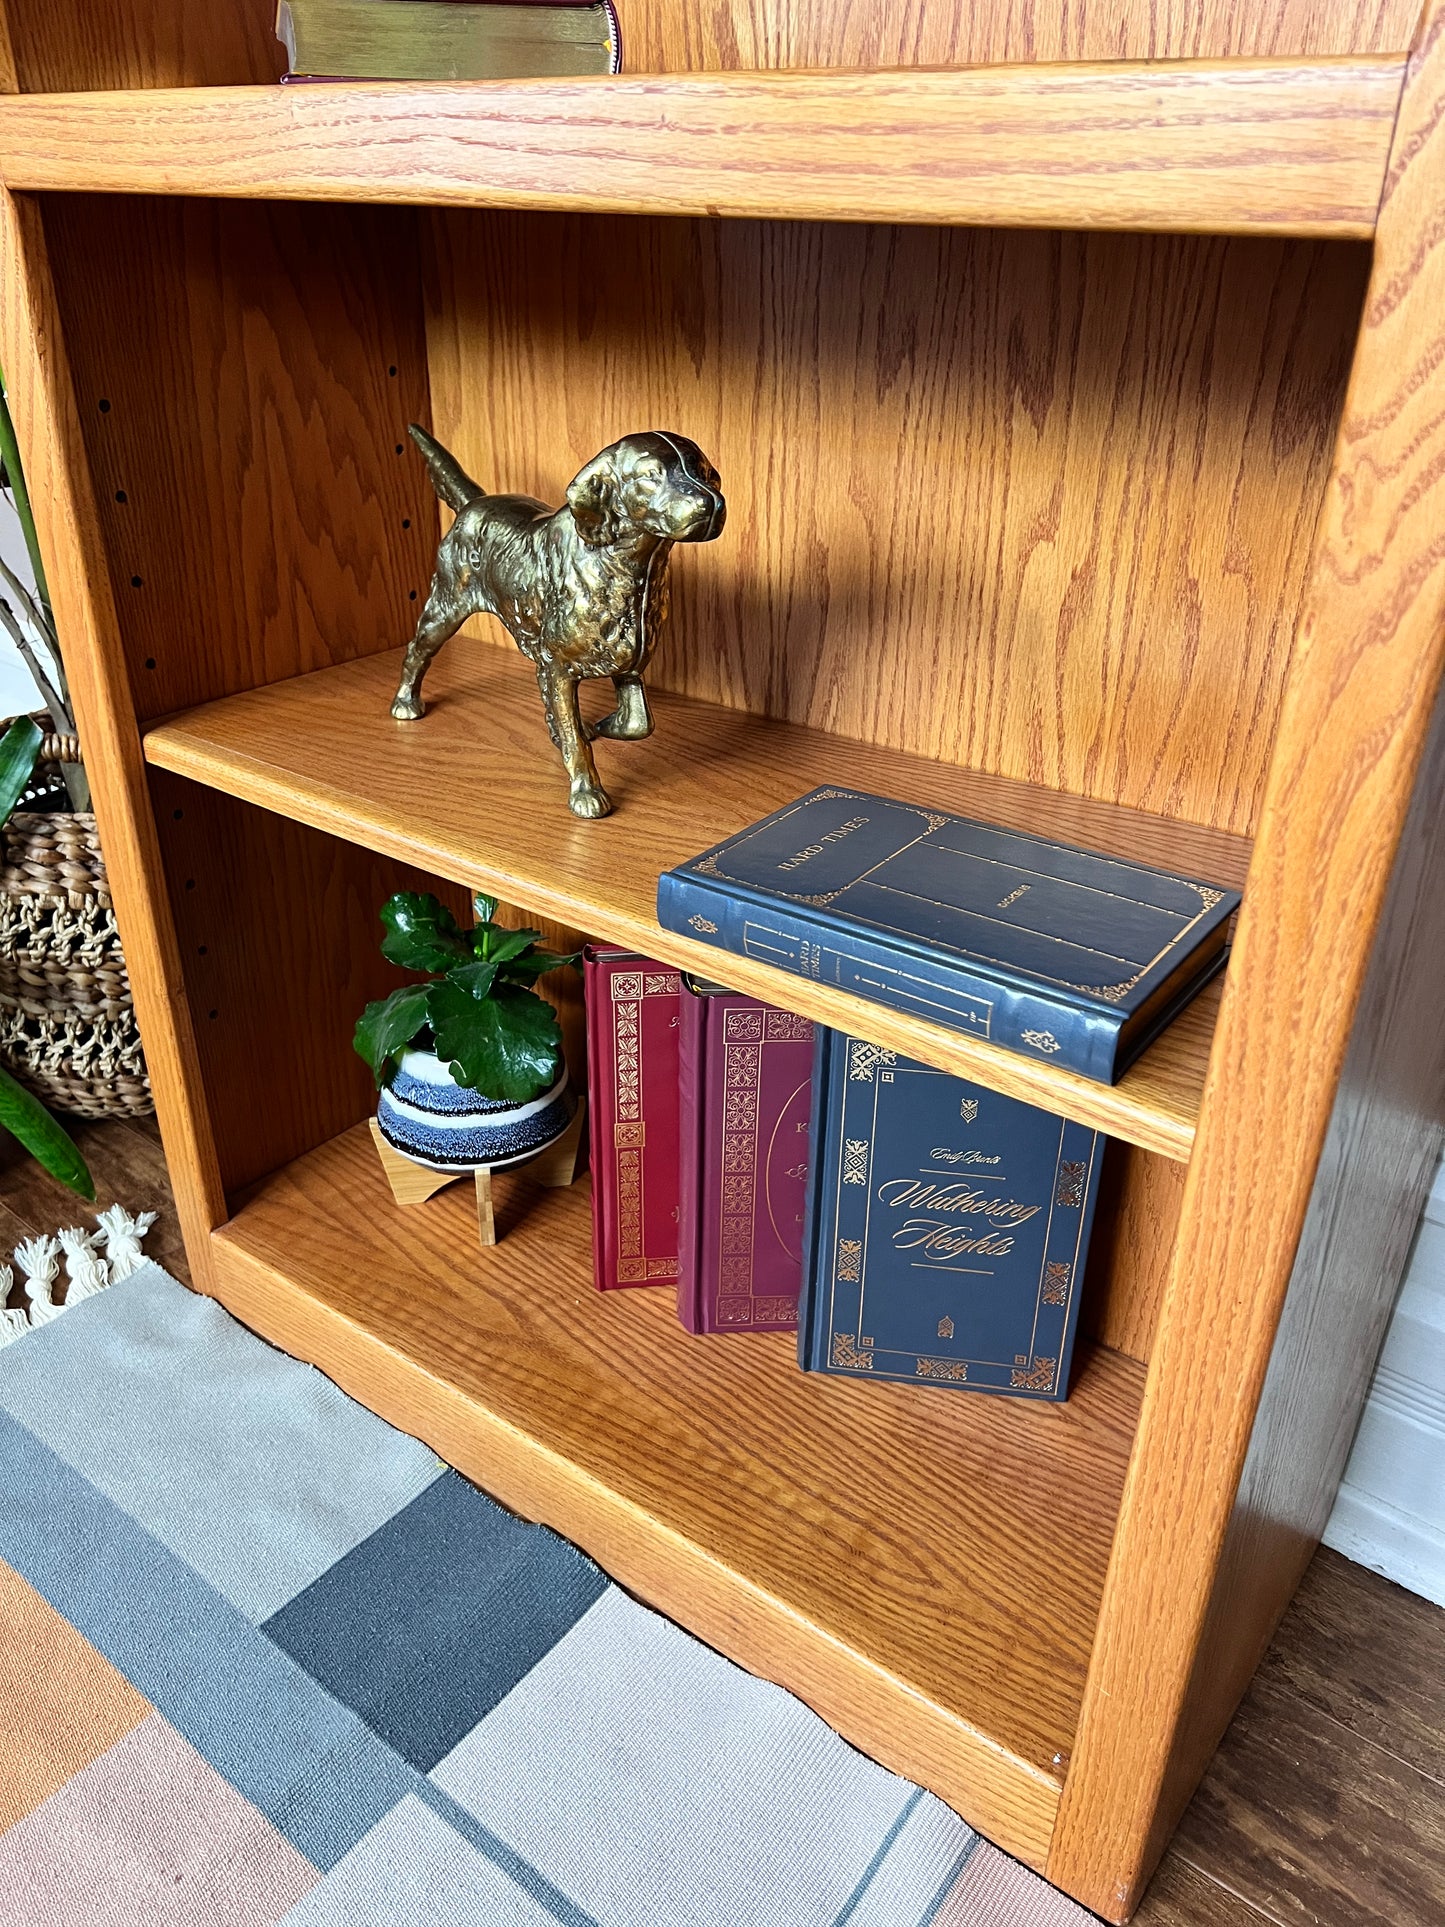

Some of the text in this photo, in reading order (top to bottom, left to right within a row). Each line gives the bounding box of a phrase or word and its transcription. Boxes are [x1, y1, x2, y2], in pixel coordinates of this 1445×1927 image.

[777, 816, 870, 870] HARD TIMES
[800, 940, 810, 975] HARD
[811, 943, 820, 978] TIMES
[930, 1147, 963, 1164] Emily
[878, 1179, 1042, 1228] Wuthering
[892, 1218, 1015, 1260] Heights
